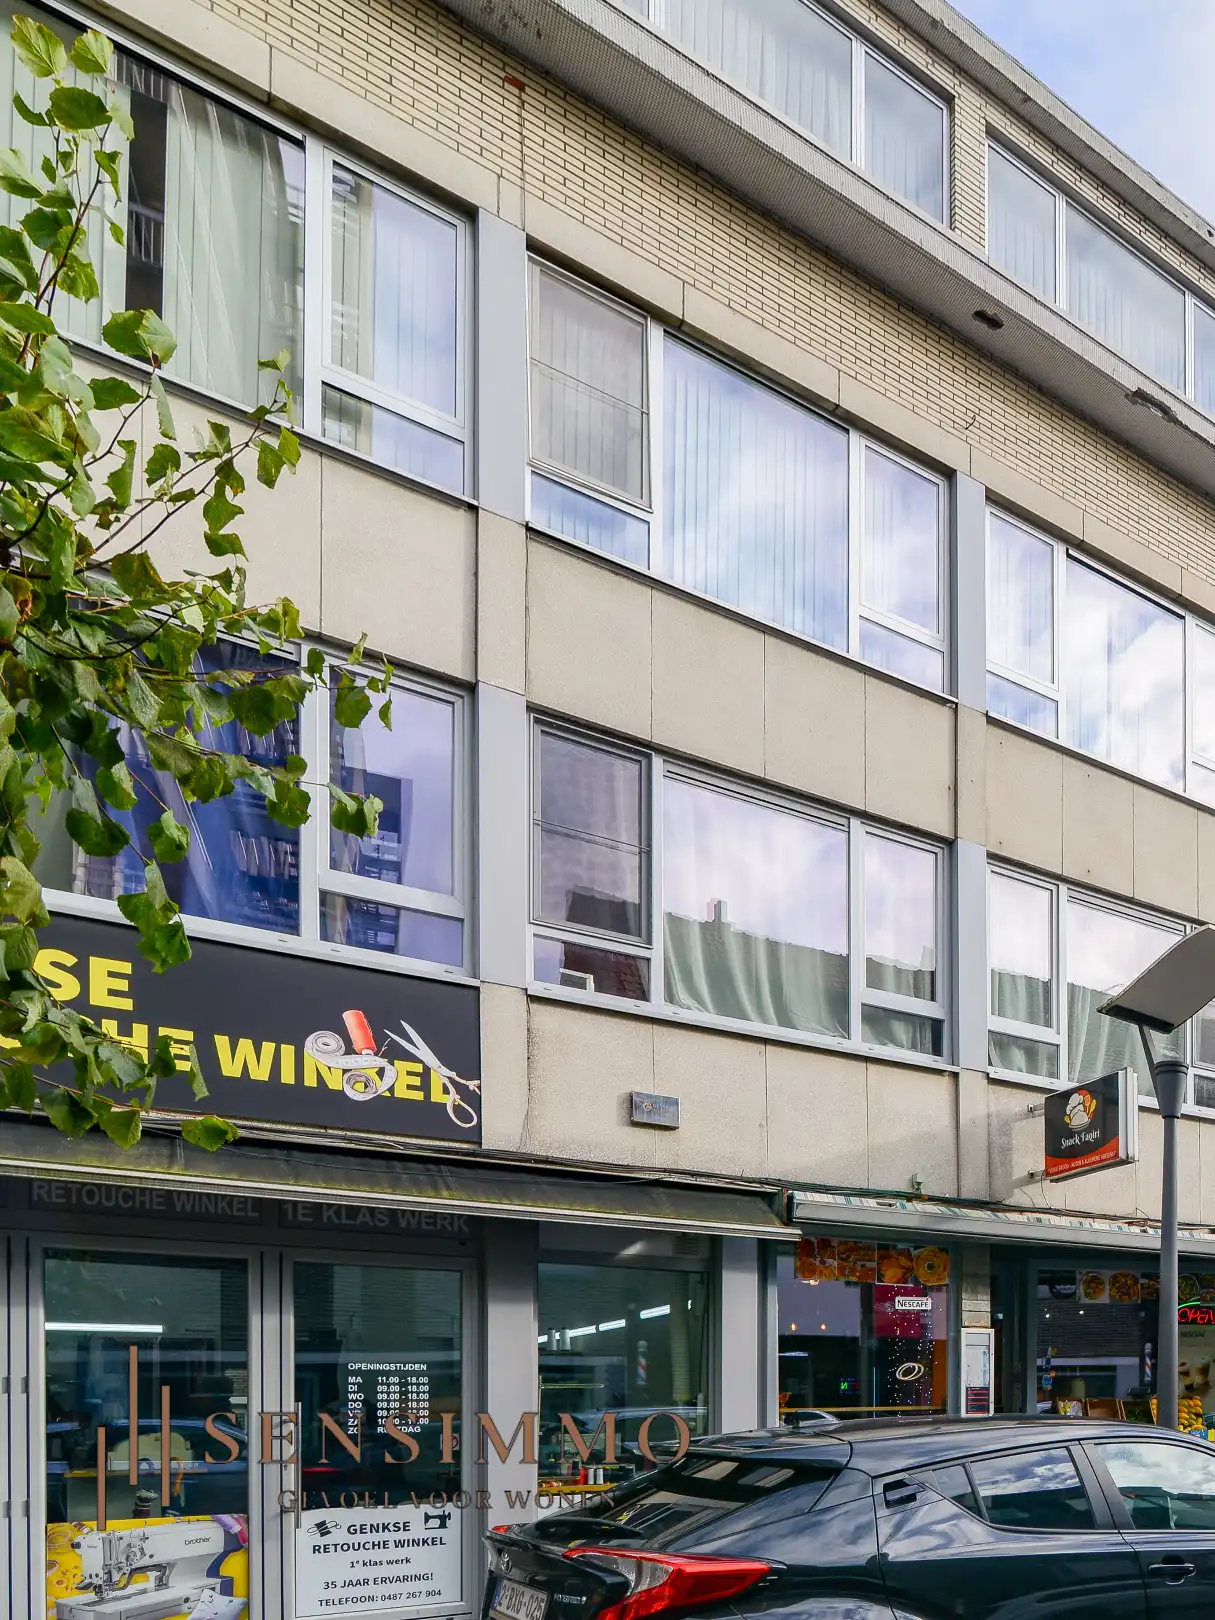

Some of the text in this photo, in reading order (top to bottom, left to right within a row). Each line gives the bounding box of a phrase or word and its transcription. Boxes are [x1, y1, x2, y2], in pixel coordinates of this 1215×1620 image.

[1061, 1133, 1081, 1149] Snack
[31, 1181, 260, 1217] RETOUCHE WINKEL
[283, 1202, 470, 1233] 1E KLAS WERK
[347, 1521, 411, 1535] GENKSE
[184, 1536, 211, 1546] brother
[312, 1537, 446, 1554] RETOUCHE WINKEL
[362, 1559, 383, 1568] klas
[386, 1556, 412, 1566] werk
[323, 1572, 434, 1590] 35 JAAR ERVARING!
[318, 1589, 442, 1607] TELEFOON: 0487 267 904
